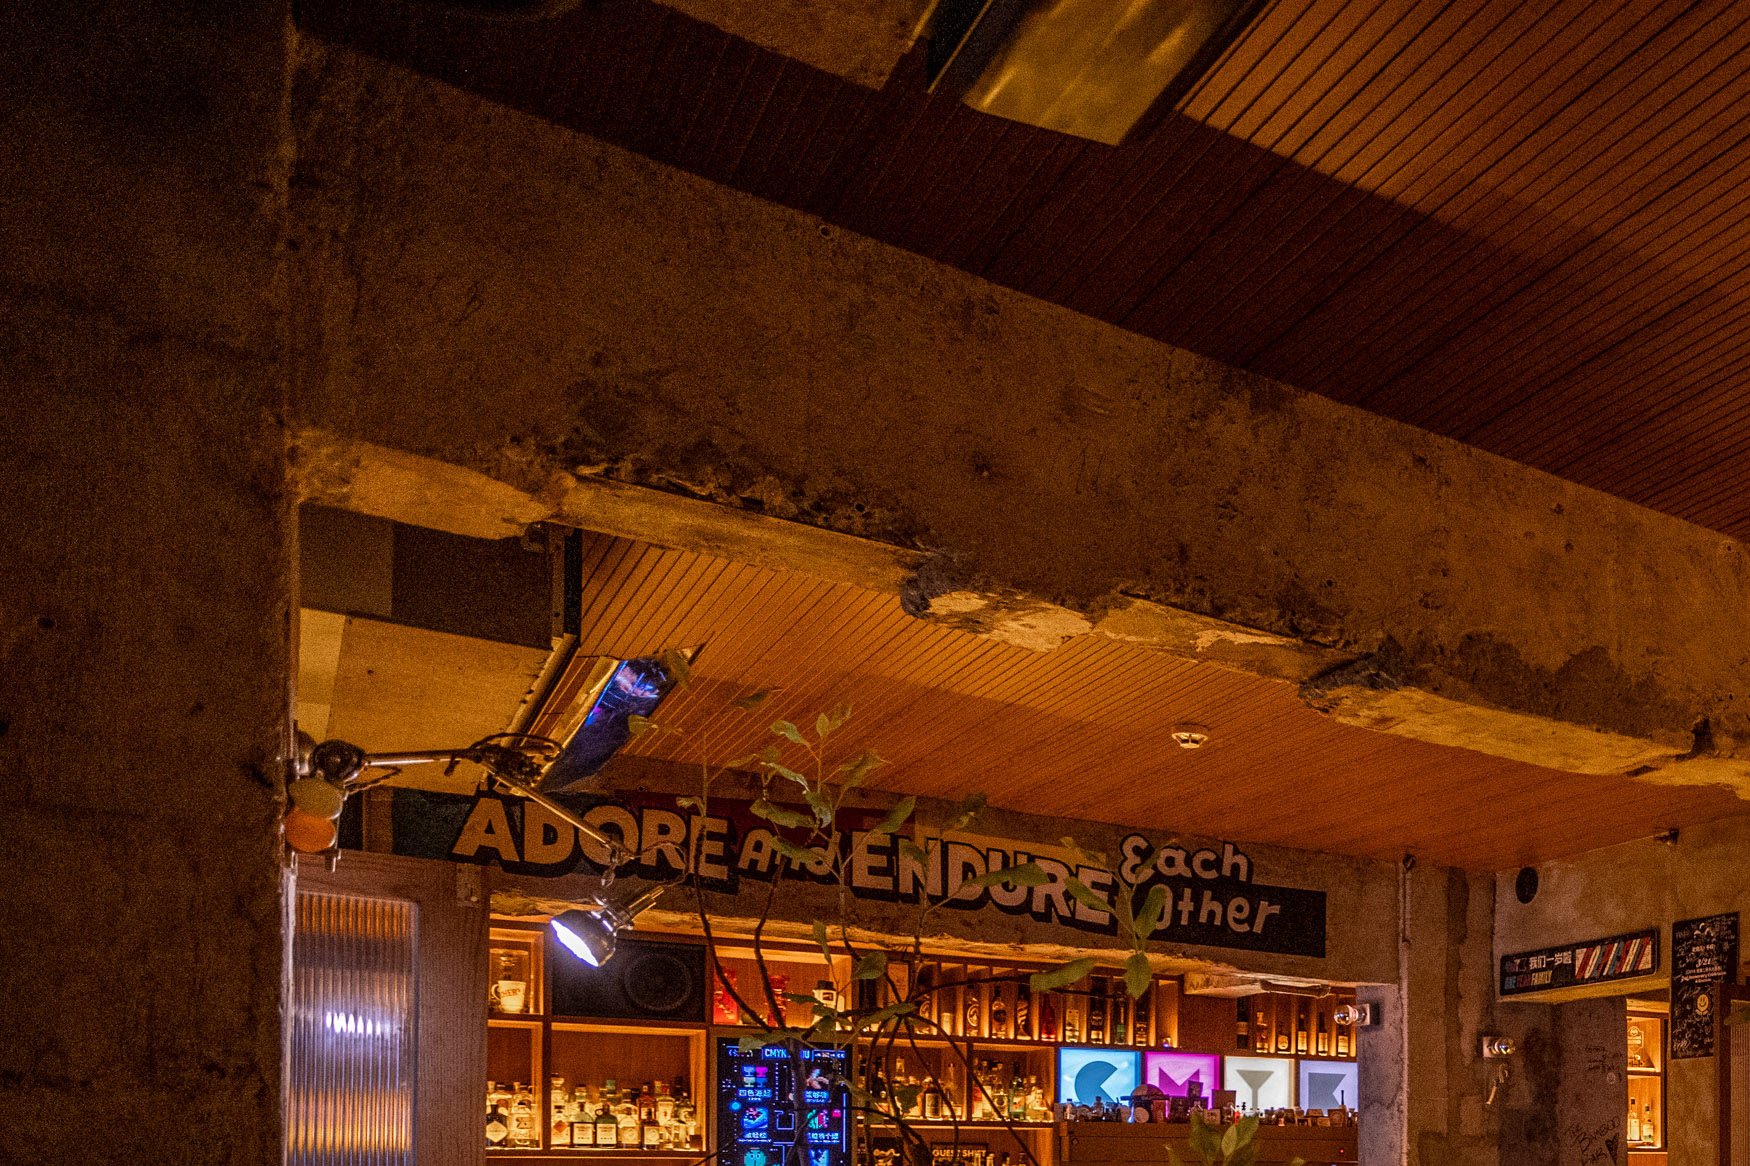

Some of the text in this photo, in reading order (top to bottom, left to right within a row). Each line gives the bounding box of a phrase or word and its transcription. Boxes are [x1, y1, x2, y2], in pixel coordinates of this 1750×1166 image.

[452, 797, 729, 880] ADORE
[851, 829, 1114, 926] ENDURE
[1120, 833, 1251, 884] Each
